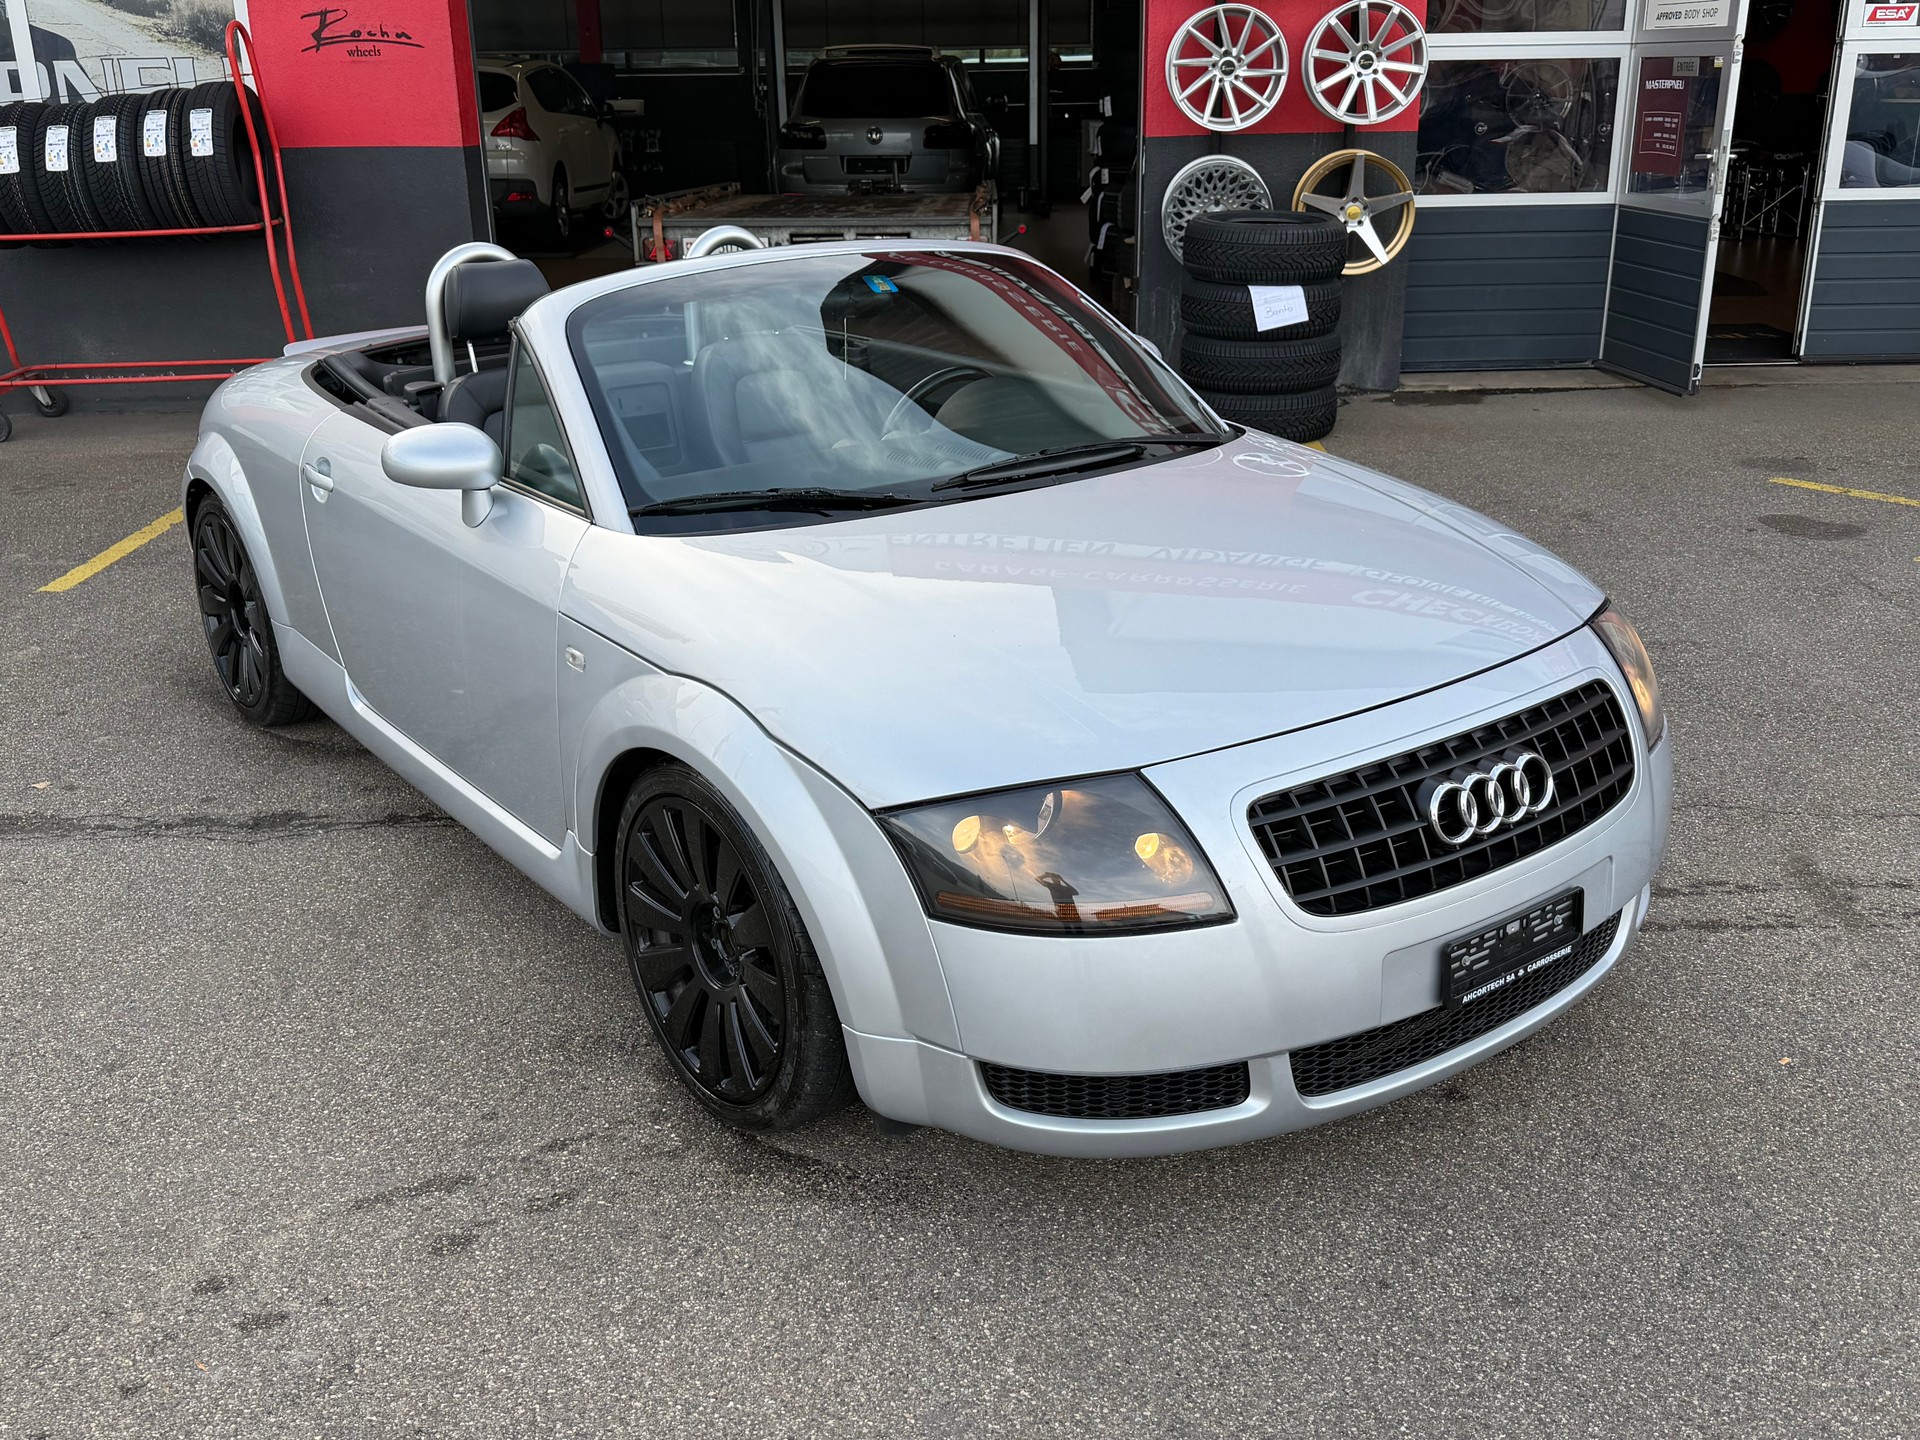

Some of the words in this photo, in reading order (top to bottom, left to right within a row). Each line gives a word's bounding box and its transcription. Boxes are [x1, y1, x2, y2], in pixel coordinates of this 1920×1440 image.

[1656, 11, 1682, 20] APPROVED
[1684, 9, 1700, 19] BODY
[1702, 8, 1718, 18] SHOP
[346, 45, 382, 57] wheels
[1677, 58, 1694, 72] ENTRÉE
[1645, 80, 1684, 89] MASTERPNEU
[1462, 978, 1505, 1003] AHCORTECH
[1506, 973, 1516, 983] SA
[1527, 945, 1572, 972] CARROSSERIE
